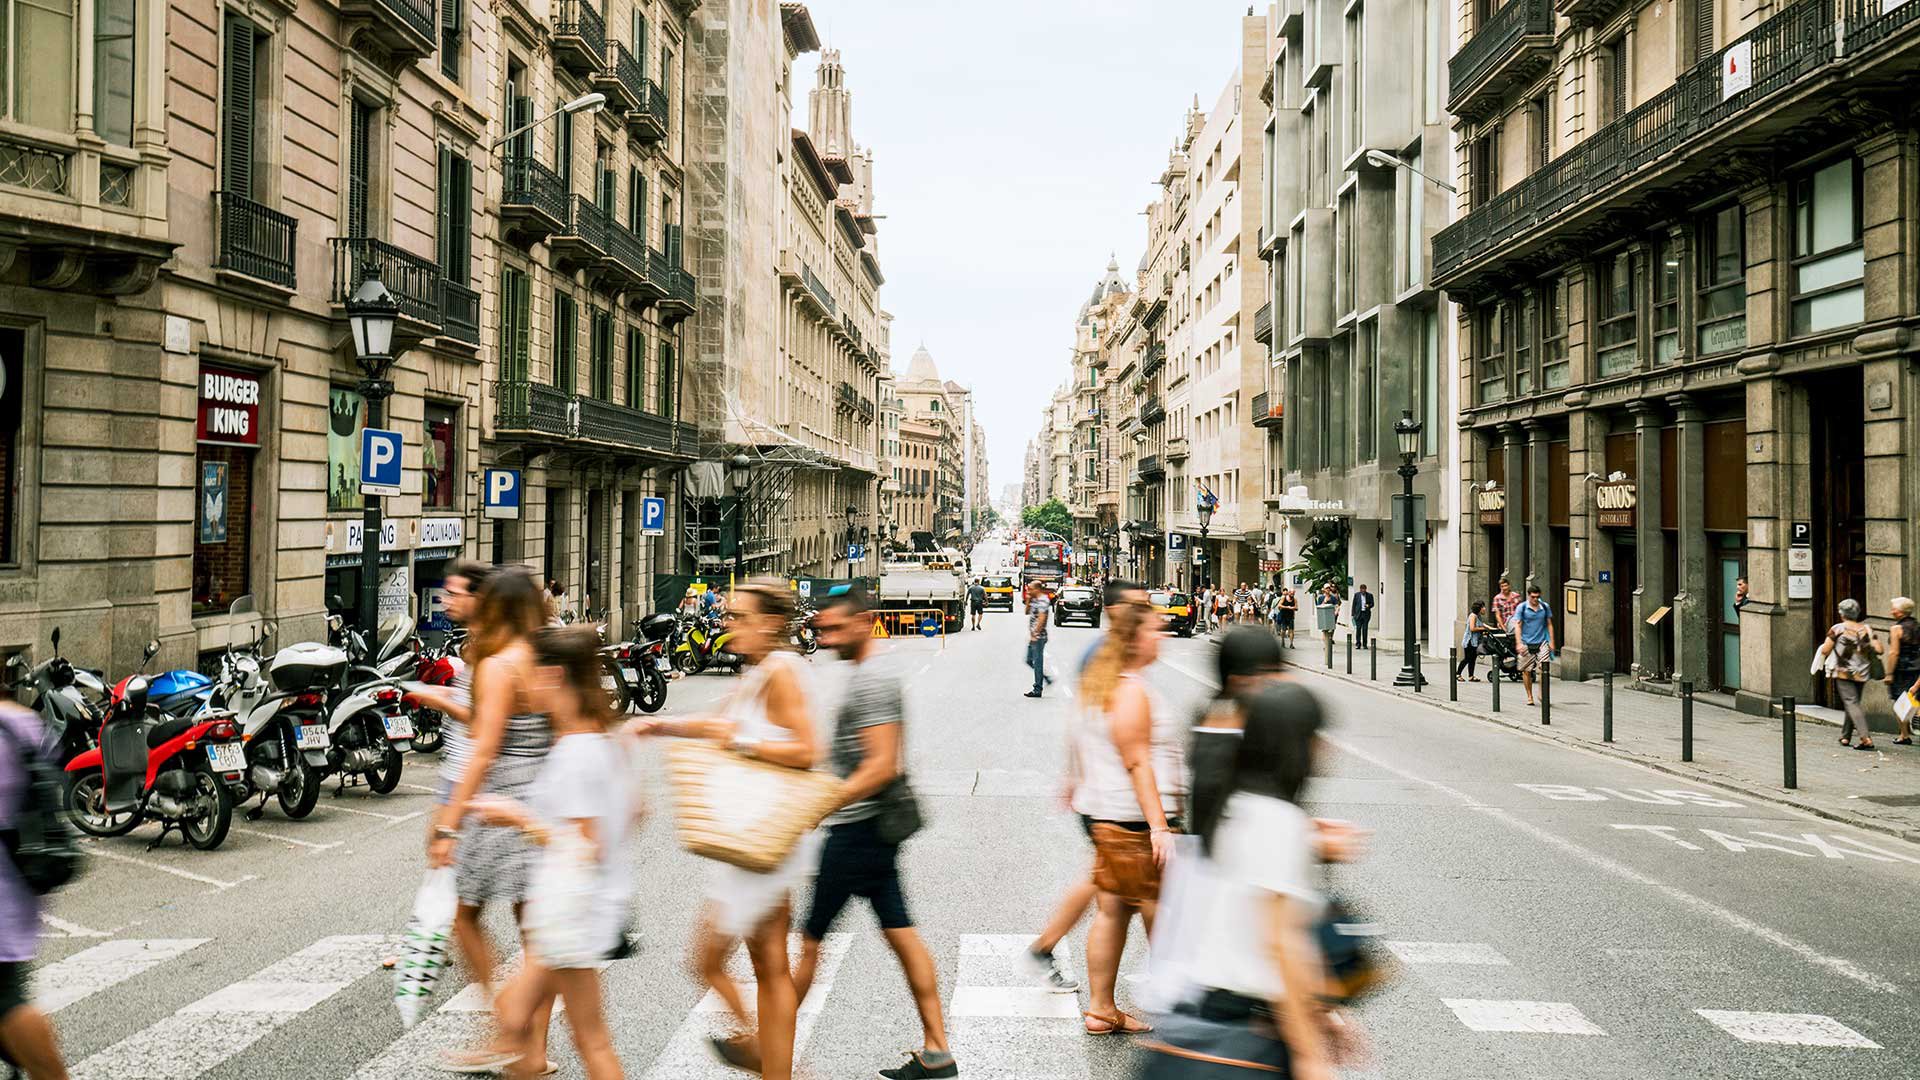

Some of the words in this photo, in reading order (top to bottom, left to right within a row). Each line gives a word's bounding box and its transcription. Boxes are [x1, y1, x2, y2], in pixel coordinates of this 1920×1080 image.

[204, 373, 259, 406] BURGER
[214, 407, 249, 436] KING
[369, 435, 395, 478] P
[490, 471, 515, 505] P
[1597, 484, 1633, 509] GINOS
[646, 501, 660, 526] P
[349, 524, 395, 546] PANG
[422, 522, 460, 543] URQUINAONA
[1171, 534, 1183, 548] P
[1796, 524, 1807, 538] P
[849, 546, 856, 558] P
[302, 727, 326, 737] 0544
[305, 736, 321, 745] JHV
[1514, 783, 1749, 808] BUS
[1610, 823, 1920, 864] TAXI
